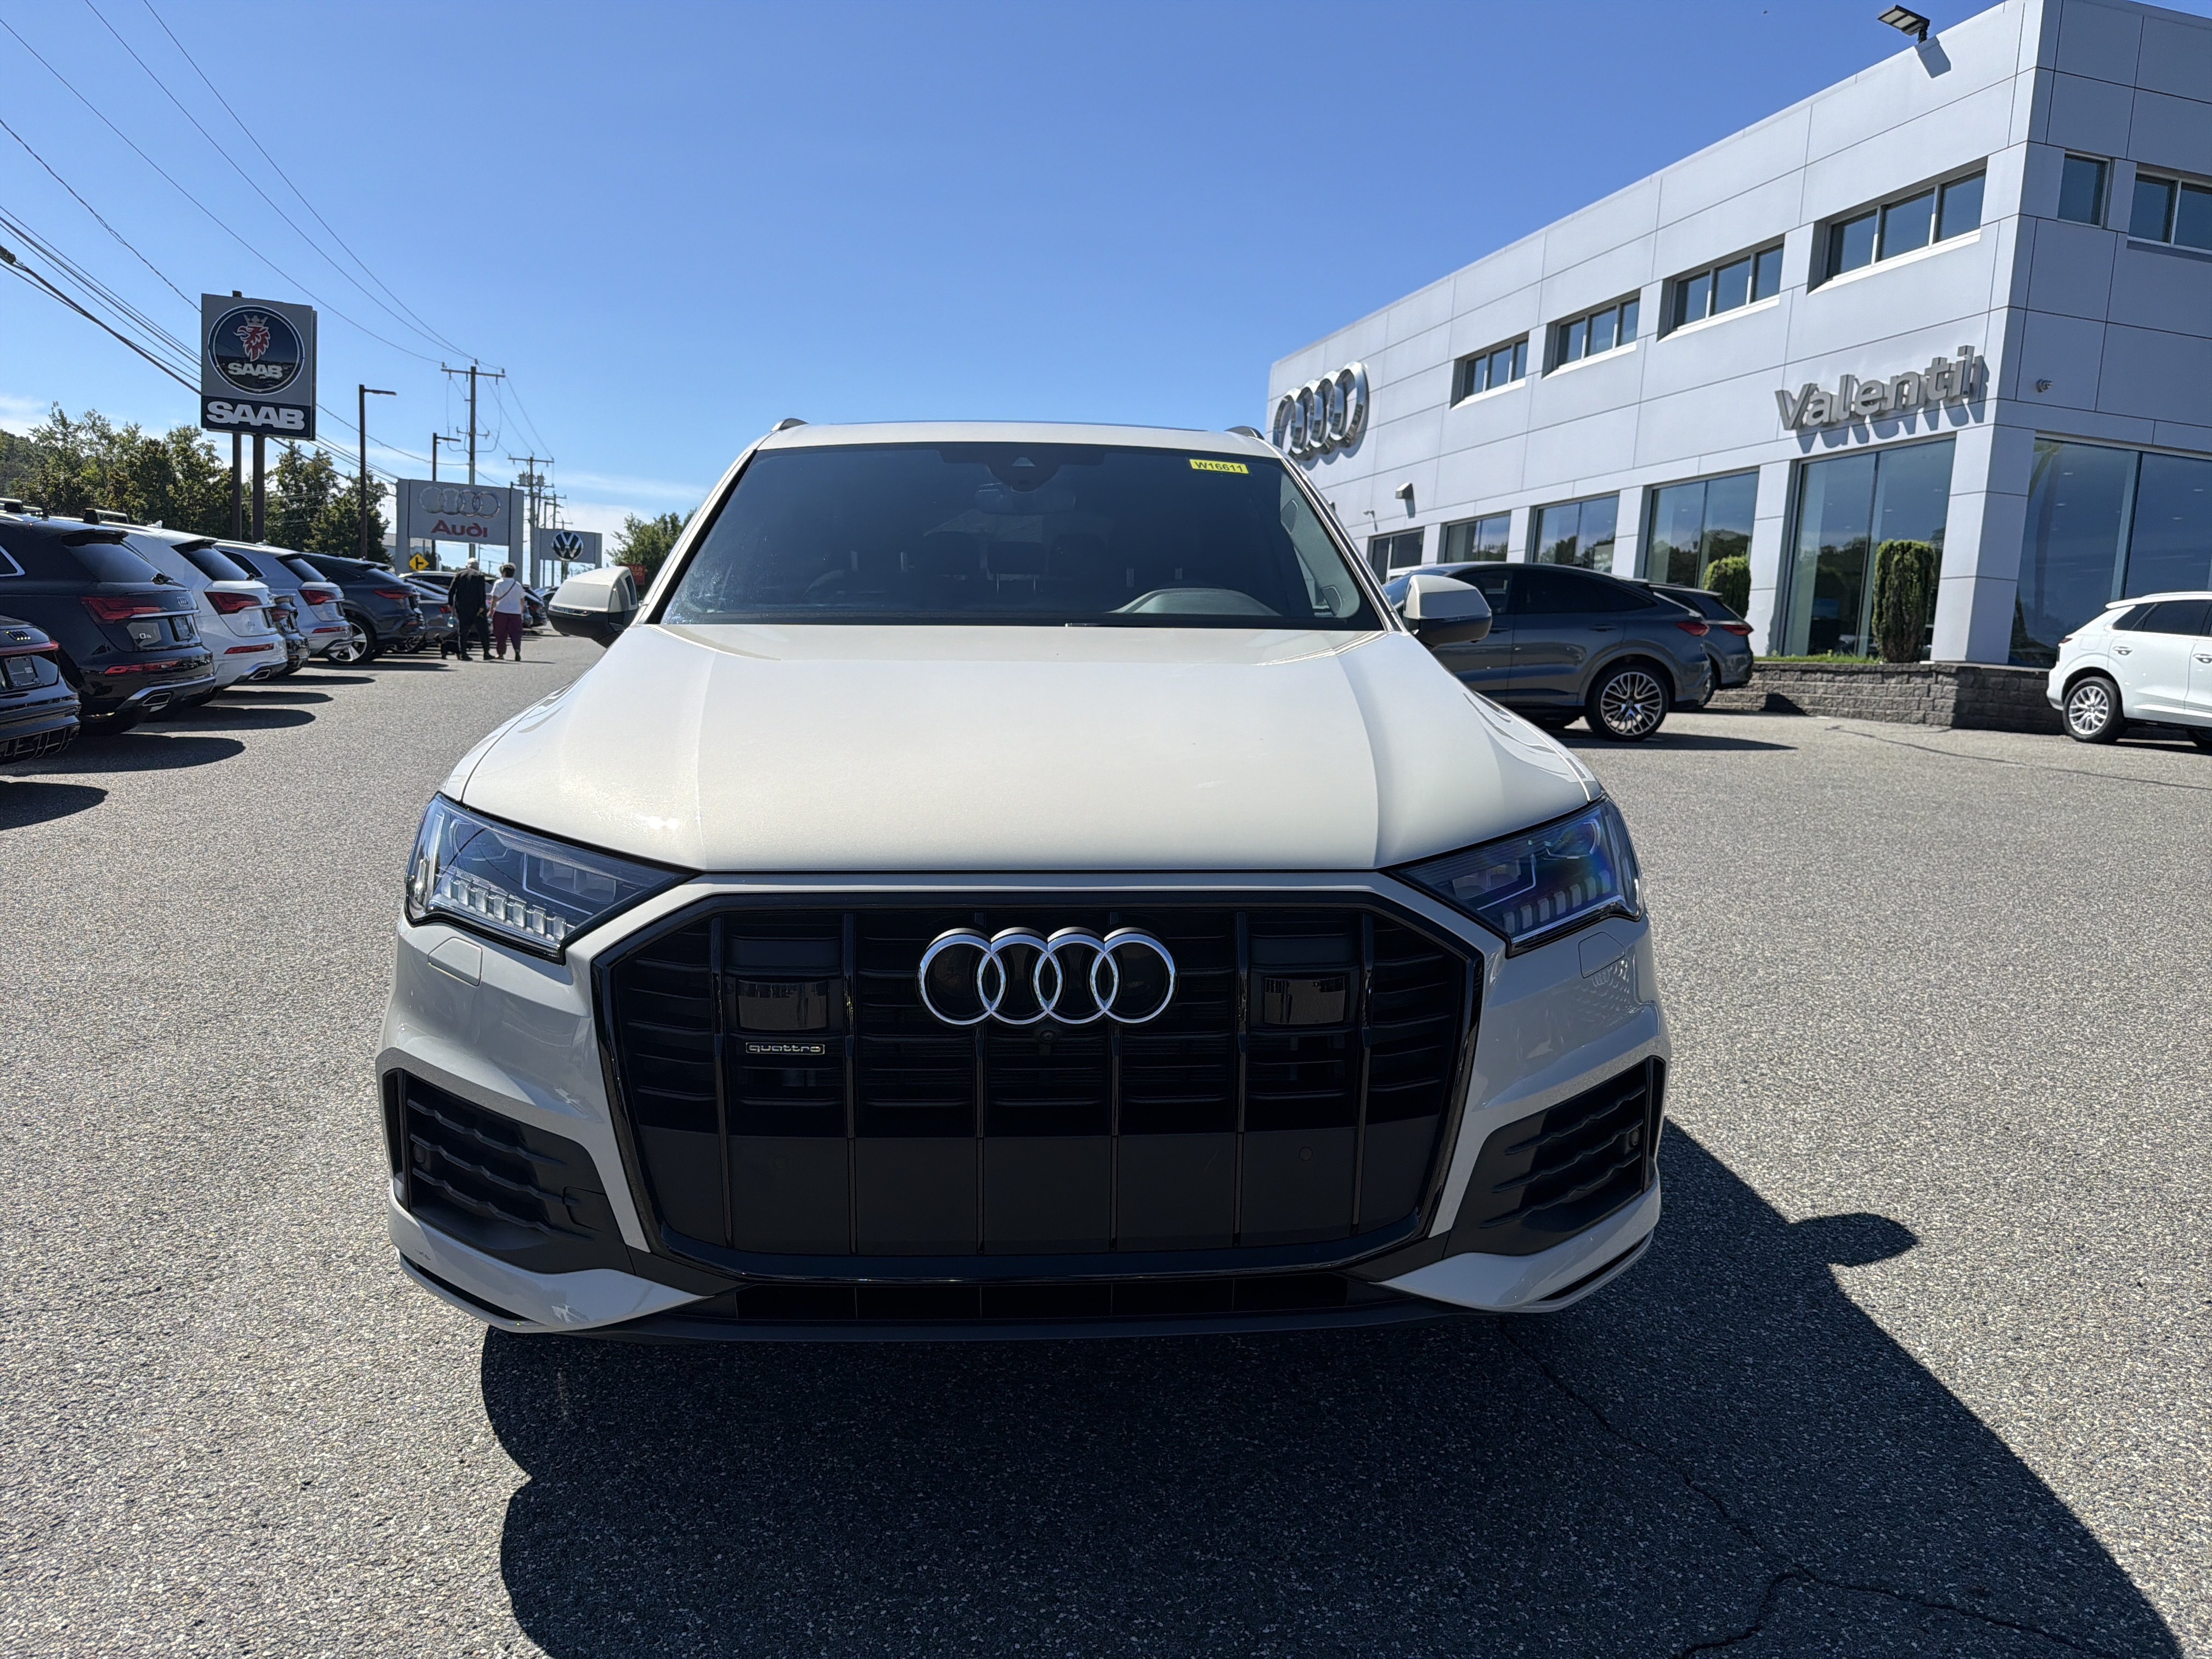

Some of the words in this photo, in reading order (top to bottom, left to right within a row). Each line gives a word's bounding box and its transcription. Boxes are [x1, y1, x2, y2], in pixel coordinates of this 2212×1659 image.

[227, 363, 283, 379] SAAB
[1774, 345, 1976, 431] Valenti
[206, 401, 305, 431] SAAB
[1194, 461, 1244, 472] W16611
[431, 519, 488, 538] Audi
[748, 1045, 821, 1053] quattro
